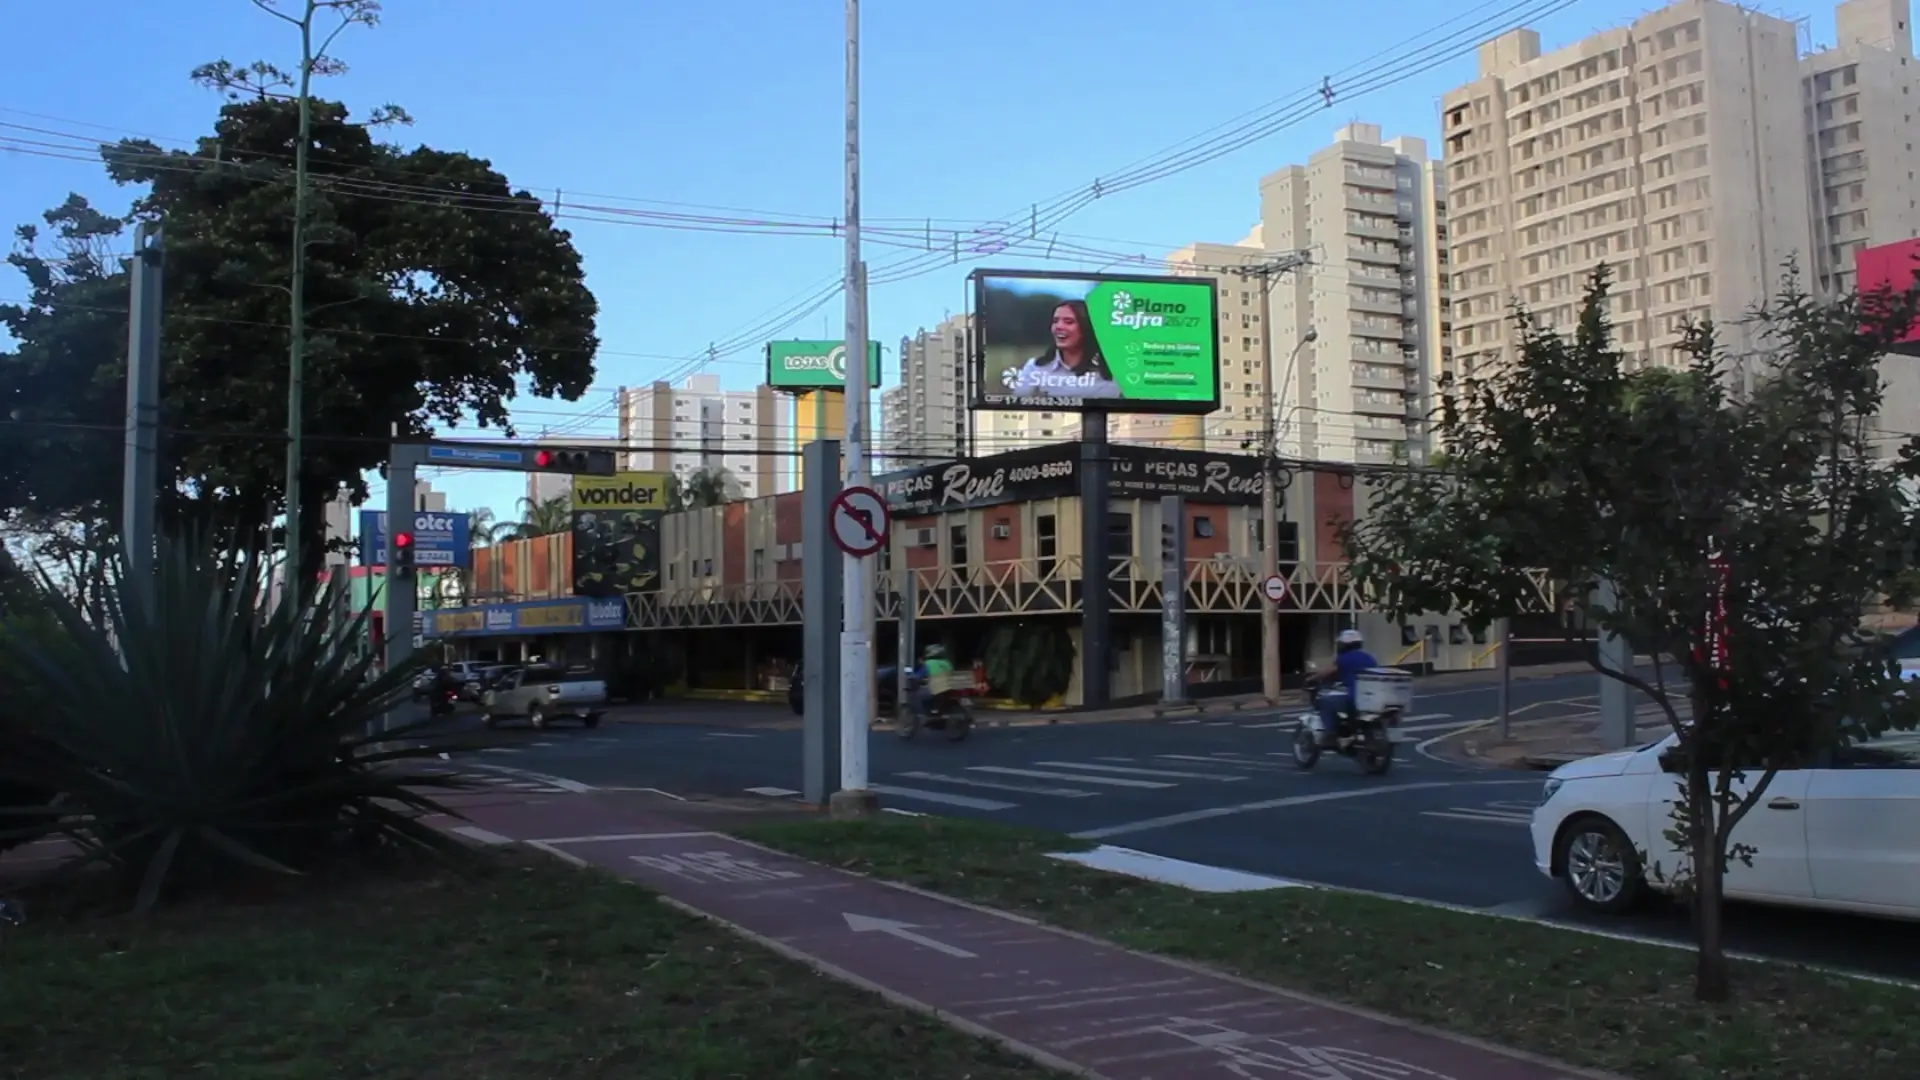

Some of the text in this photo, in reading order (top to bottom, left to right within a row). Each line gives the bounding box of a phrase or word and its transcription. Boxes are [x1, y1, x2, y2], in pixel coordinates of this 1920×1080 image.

[1132, 298, 1187, 314] Plano
[1110, 311, 1163, 330] Safra
[784, 356, 828, 369] LOJAS
[1028, 371, 1096, 387] Sicredi
[1144, 461, 1199, 480] PEÇAS
[577, 482, 658, 504] vonder
[887, 474, 934, 496] PEÇAS
[940, 464, 1006, 507] Renê
